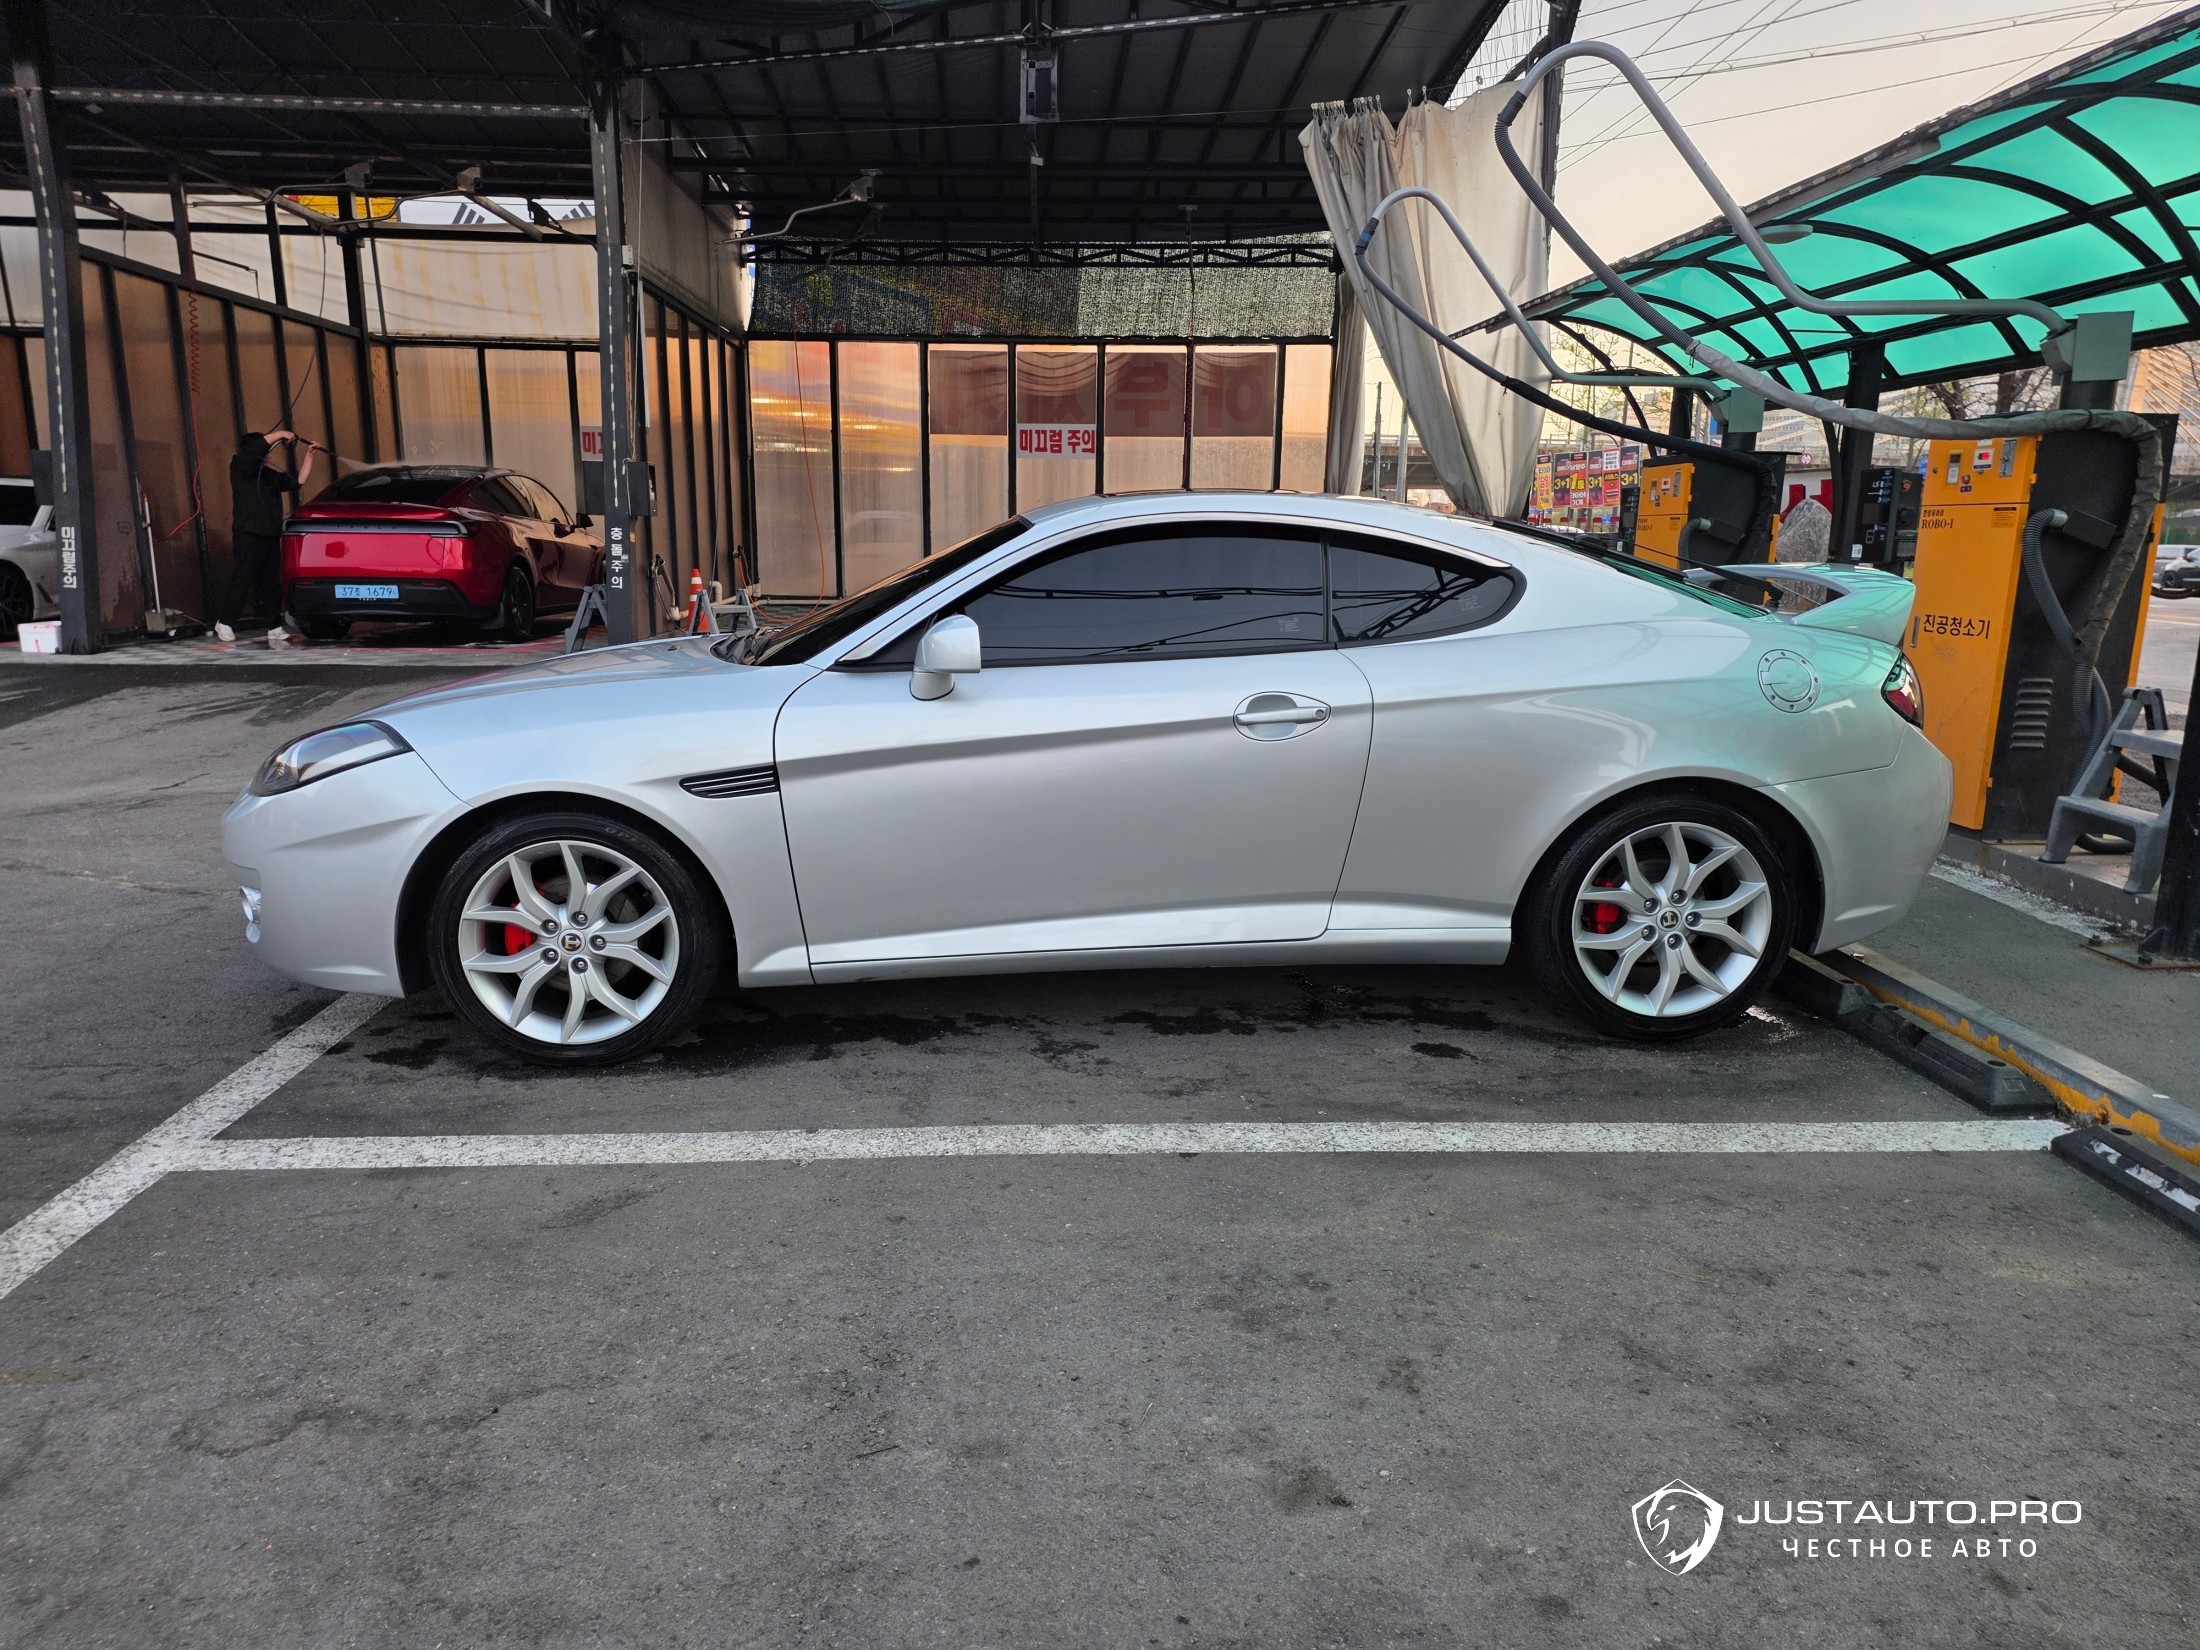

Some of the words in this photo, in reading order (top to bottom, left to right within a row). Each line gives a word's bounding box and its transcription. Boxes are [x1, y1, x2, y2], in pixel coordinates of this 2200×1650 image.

[1019, 429, 1063, 454] 미끄럼
[1067, 429, 1095, 454] 주의
[1554, 477, 1570, 489] 3+1
[1621, 472, 1638, 486] 3+1
[367, 586, 393, 597] 1679
[1923, 614, 1990, 640] 진공청소기
